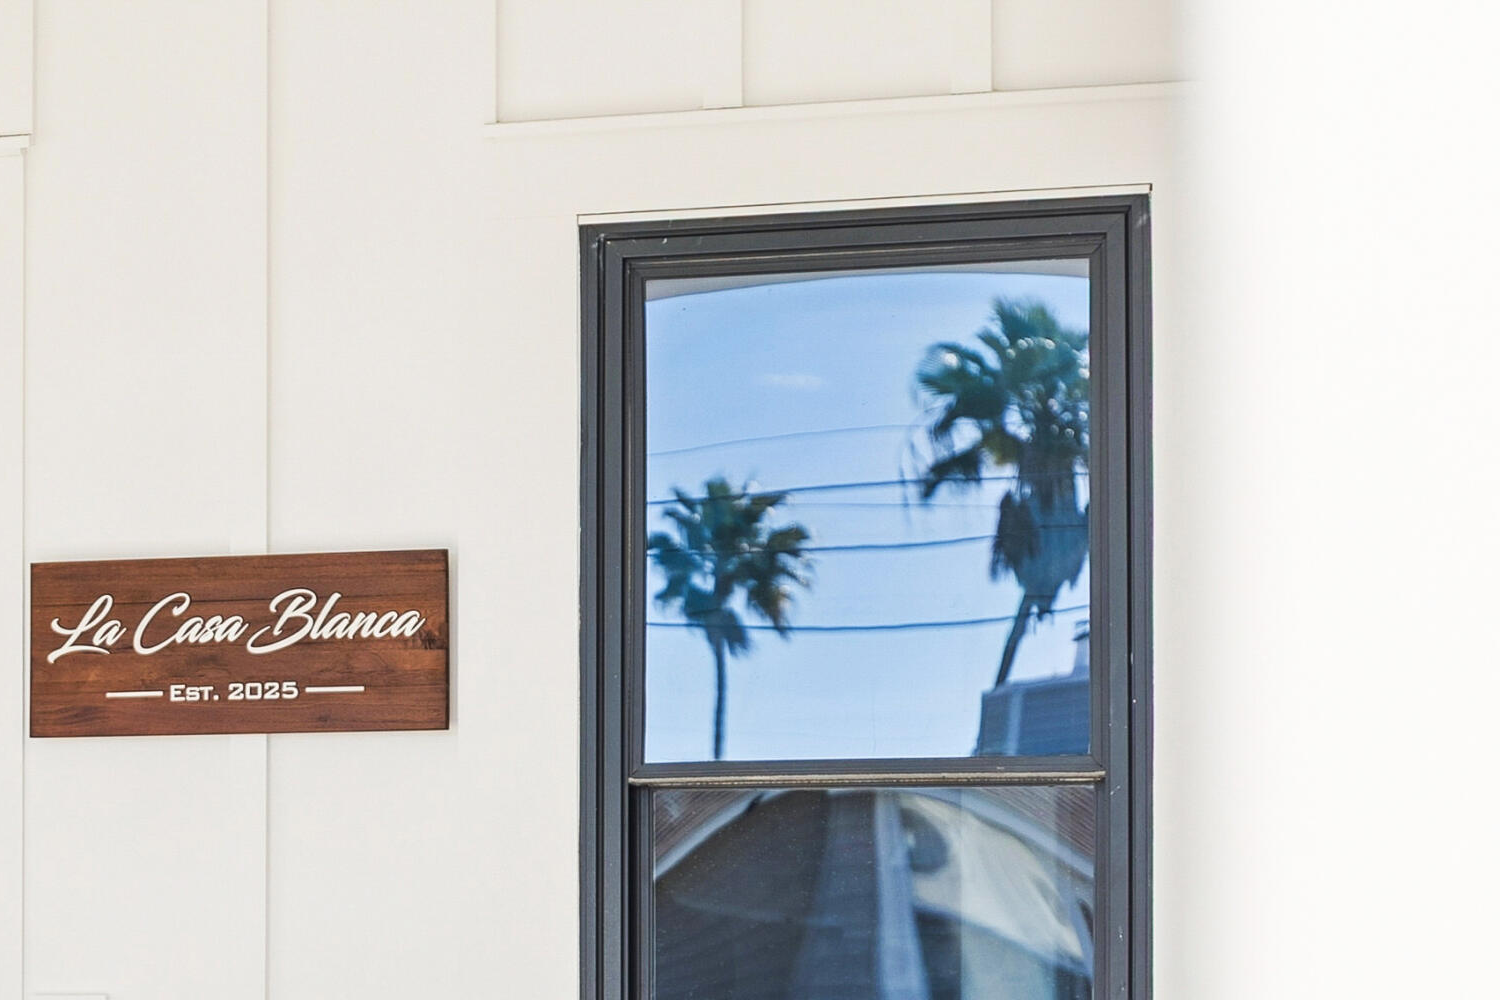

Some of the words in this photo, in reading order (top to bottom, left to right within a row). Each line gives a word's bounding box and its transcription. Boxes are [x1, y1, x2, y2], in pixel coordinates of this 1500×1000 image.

[47, 594, 127, 664] La
[133, 592, 249, 655] Casa
[247, 588, 426, 655] Blanca
[227, 681, 299, 700] 2025
